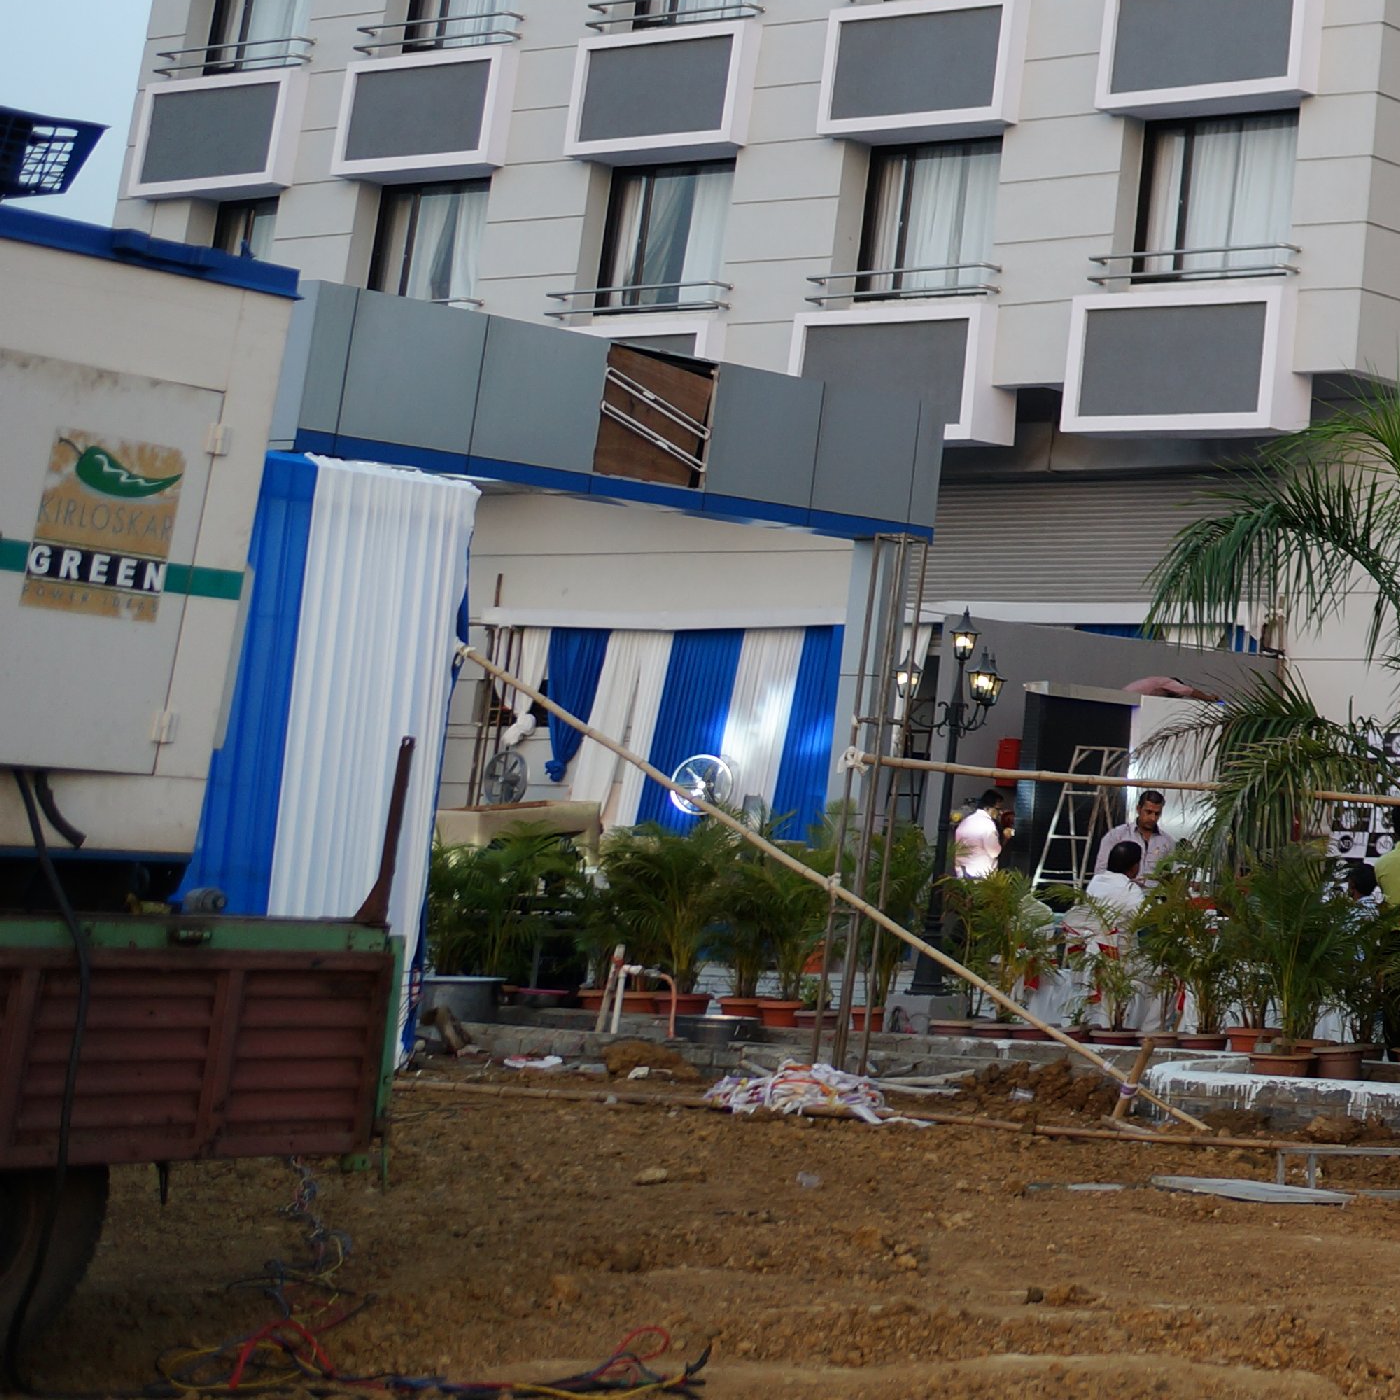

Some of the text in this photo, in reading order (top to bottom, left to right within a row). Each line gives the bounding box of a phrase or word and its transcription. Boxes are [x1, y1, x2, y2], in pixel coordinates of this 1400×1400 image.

[37, 497, 174, 540] KIRLOSKAR
[28, 545, 166, 591] GREEN
[22, 584, 90, 603] POWER
